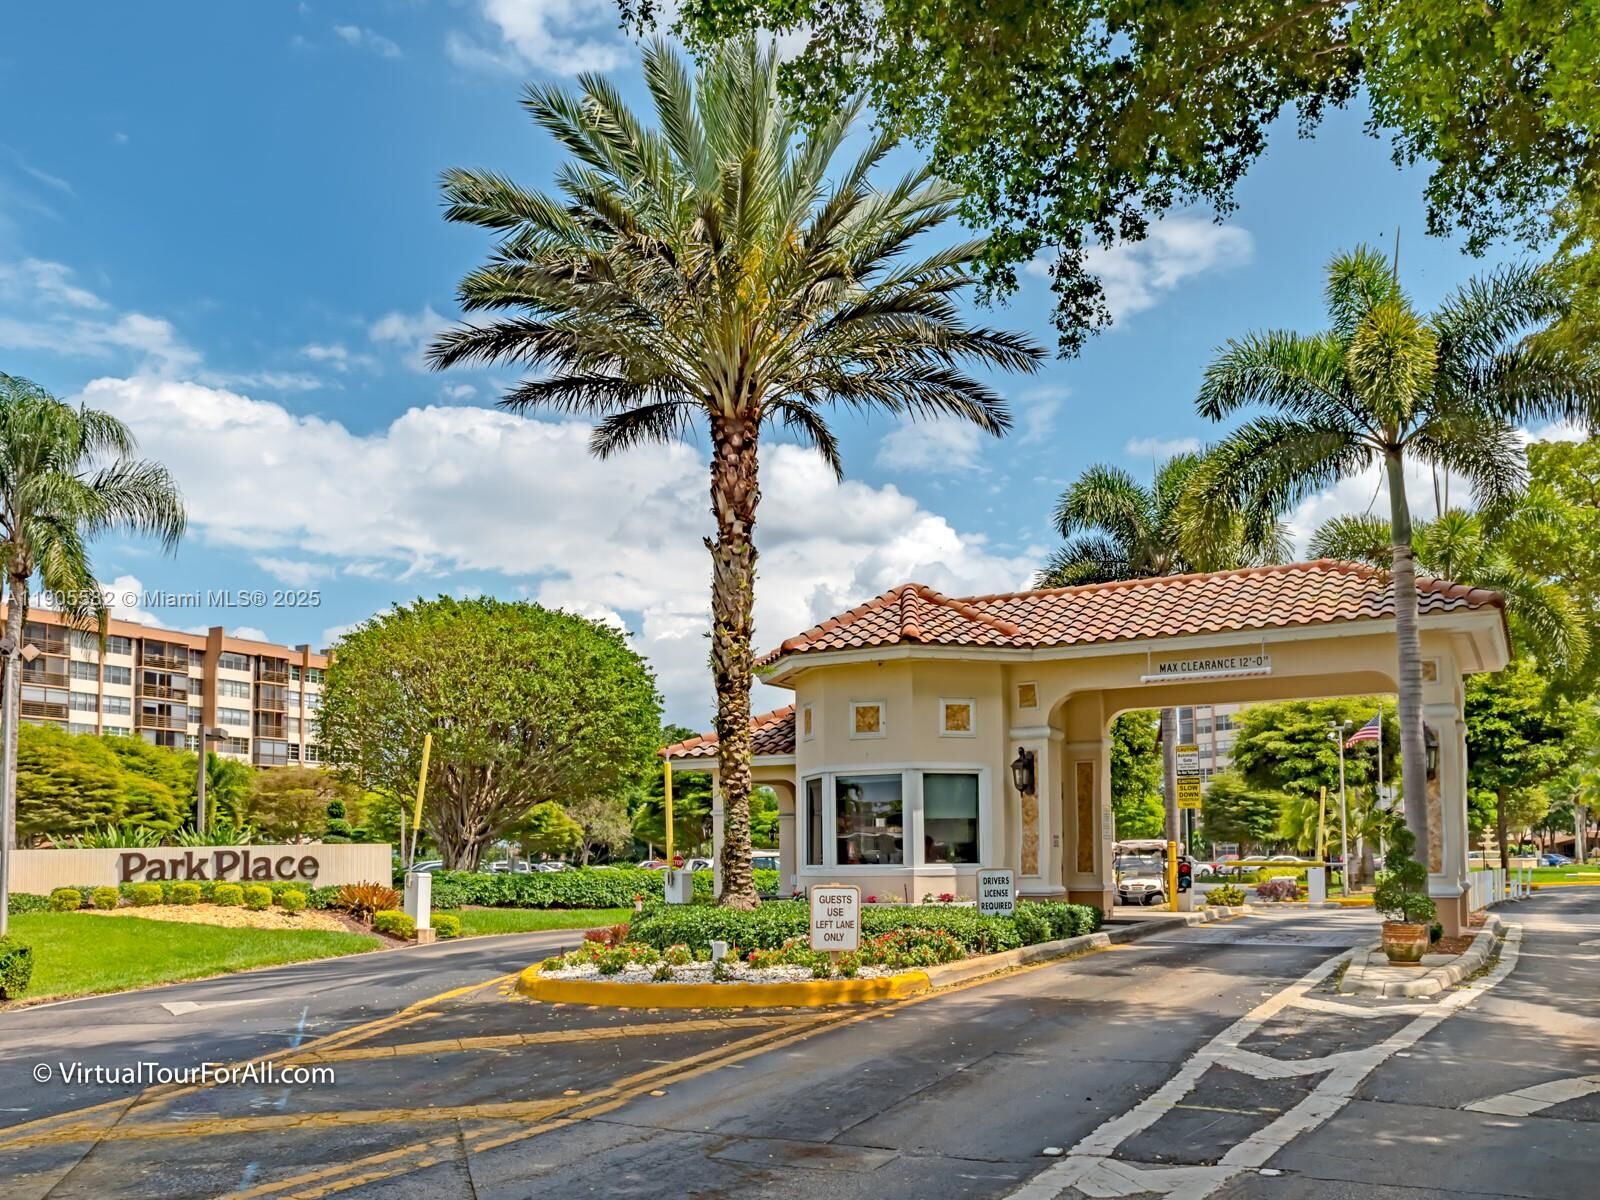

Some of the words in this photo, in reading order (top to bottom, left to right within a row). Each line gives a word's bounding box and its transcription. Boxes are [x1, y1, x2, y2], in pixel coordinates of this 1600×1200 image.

[1159, 663, 1178, 673] MAX
[1181, 658, 1236, 671] CLEARANCE
[1239, 656, 1269, 667] 12'-0"
[120, 851, 210, 882] Park
[213, 850, 320, 881] Place
[982, 876, 1010, 885] DRIVERS
[984, 889, 1009, 898] LICENSE
[818, 895, 852, 904] GUESTS
[981, 901, 1013, 910] REQUIRED
[827, 907, 844, 917] USE
[815, 920, 833, 929] LEFT
[835, 920, 855, 929] LANE
[823, 932, 844, 942] ONLY
